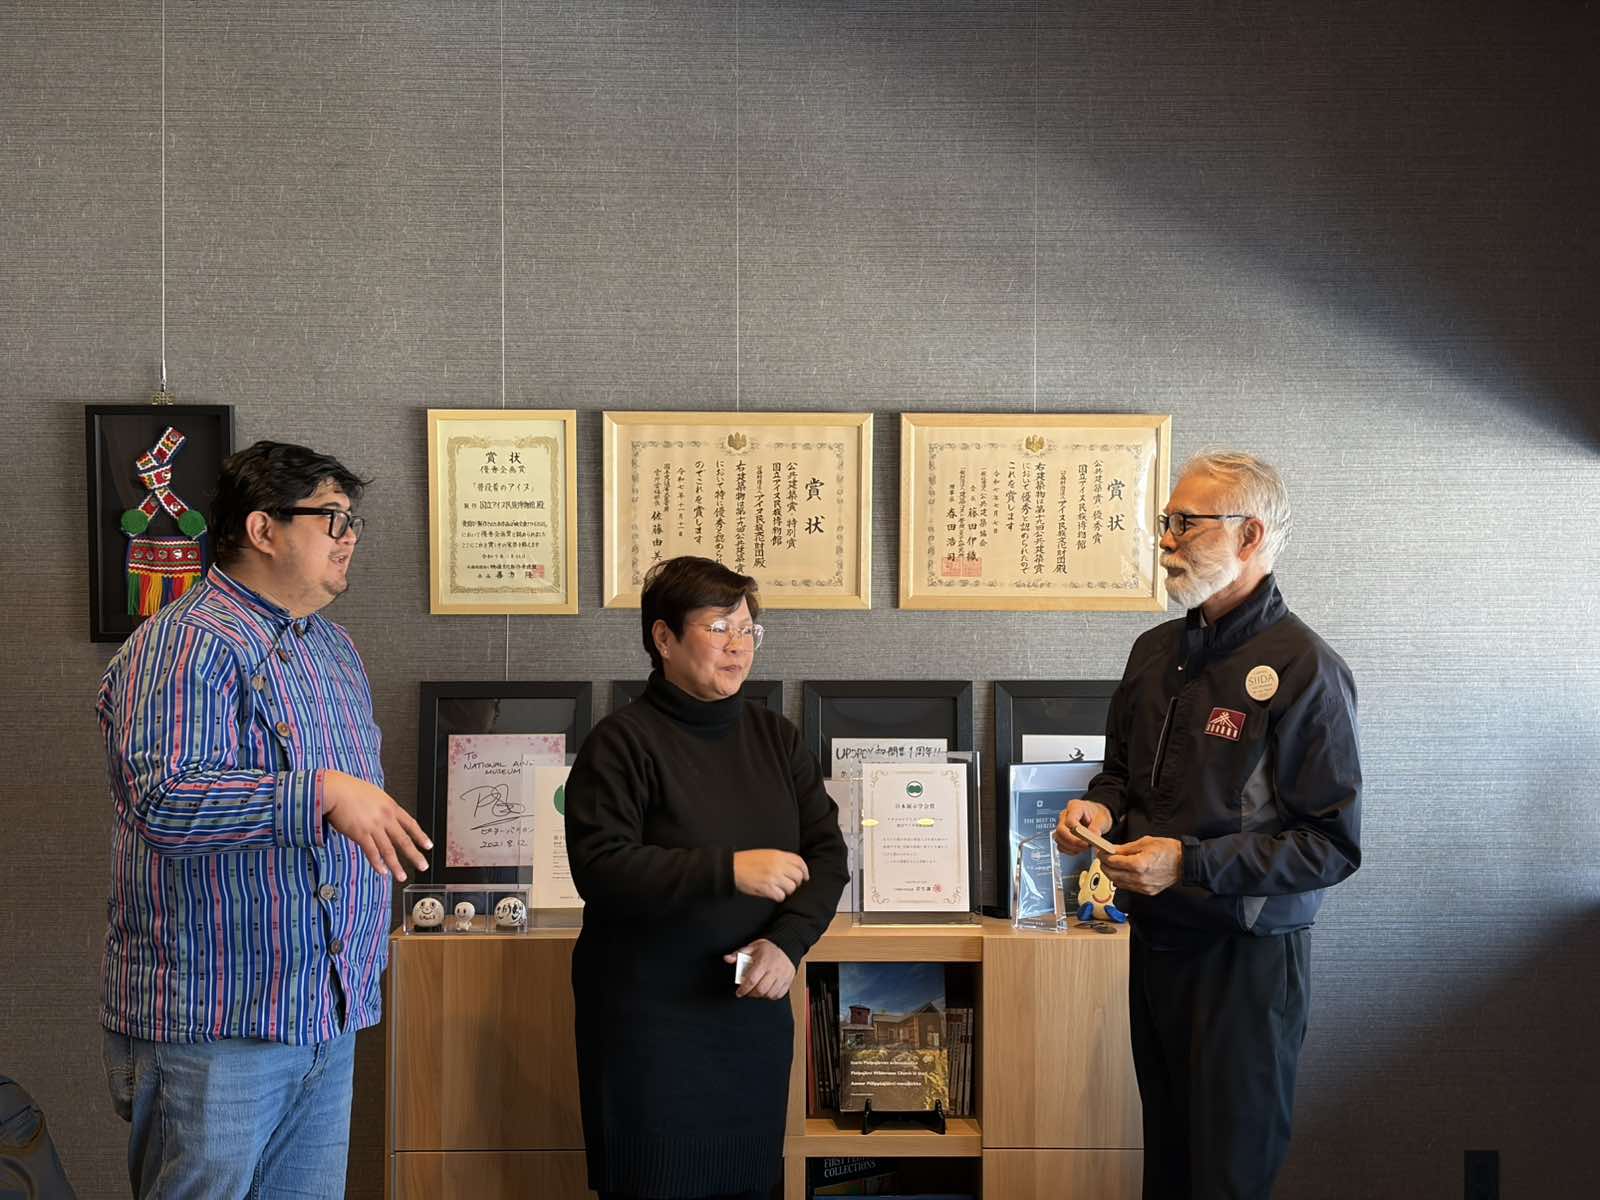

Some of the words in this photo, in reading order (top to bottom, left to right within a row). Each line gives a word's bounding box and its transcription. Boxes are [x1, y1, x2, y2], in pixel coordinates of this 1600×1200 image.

[485, 451, 522, 464] 賞状
[694, 461, 704, 544] のでこれを賞します
[772, 462, 782, 546] 国立アイヌ民族博物館
[805, 477, 825, 534] 賞状
[1006, 461, 1016, 531] これを賞します
[1077, 464, 1088, 550] 国立アイヌ民族博物館
[1107, 478, 1125, 531] 賞状
